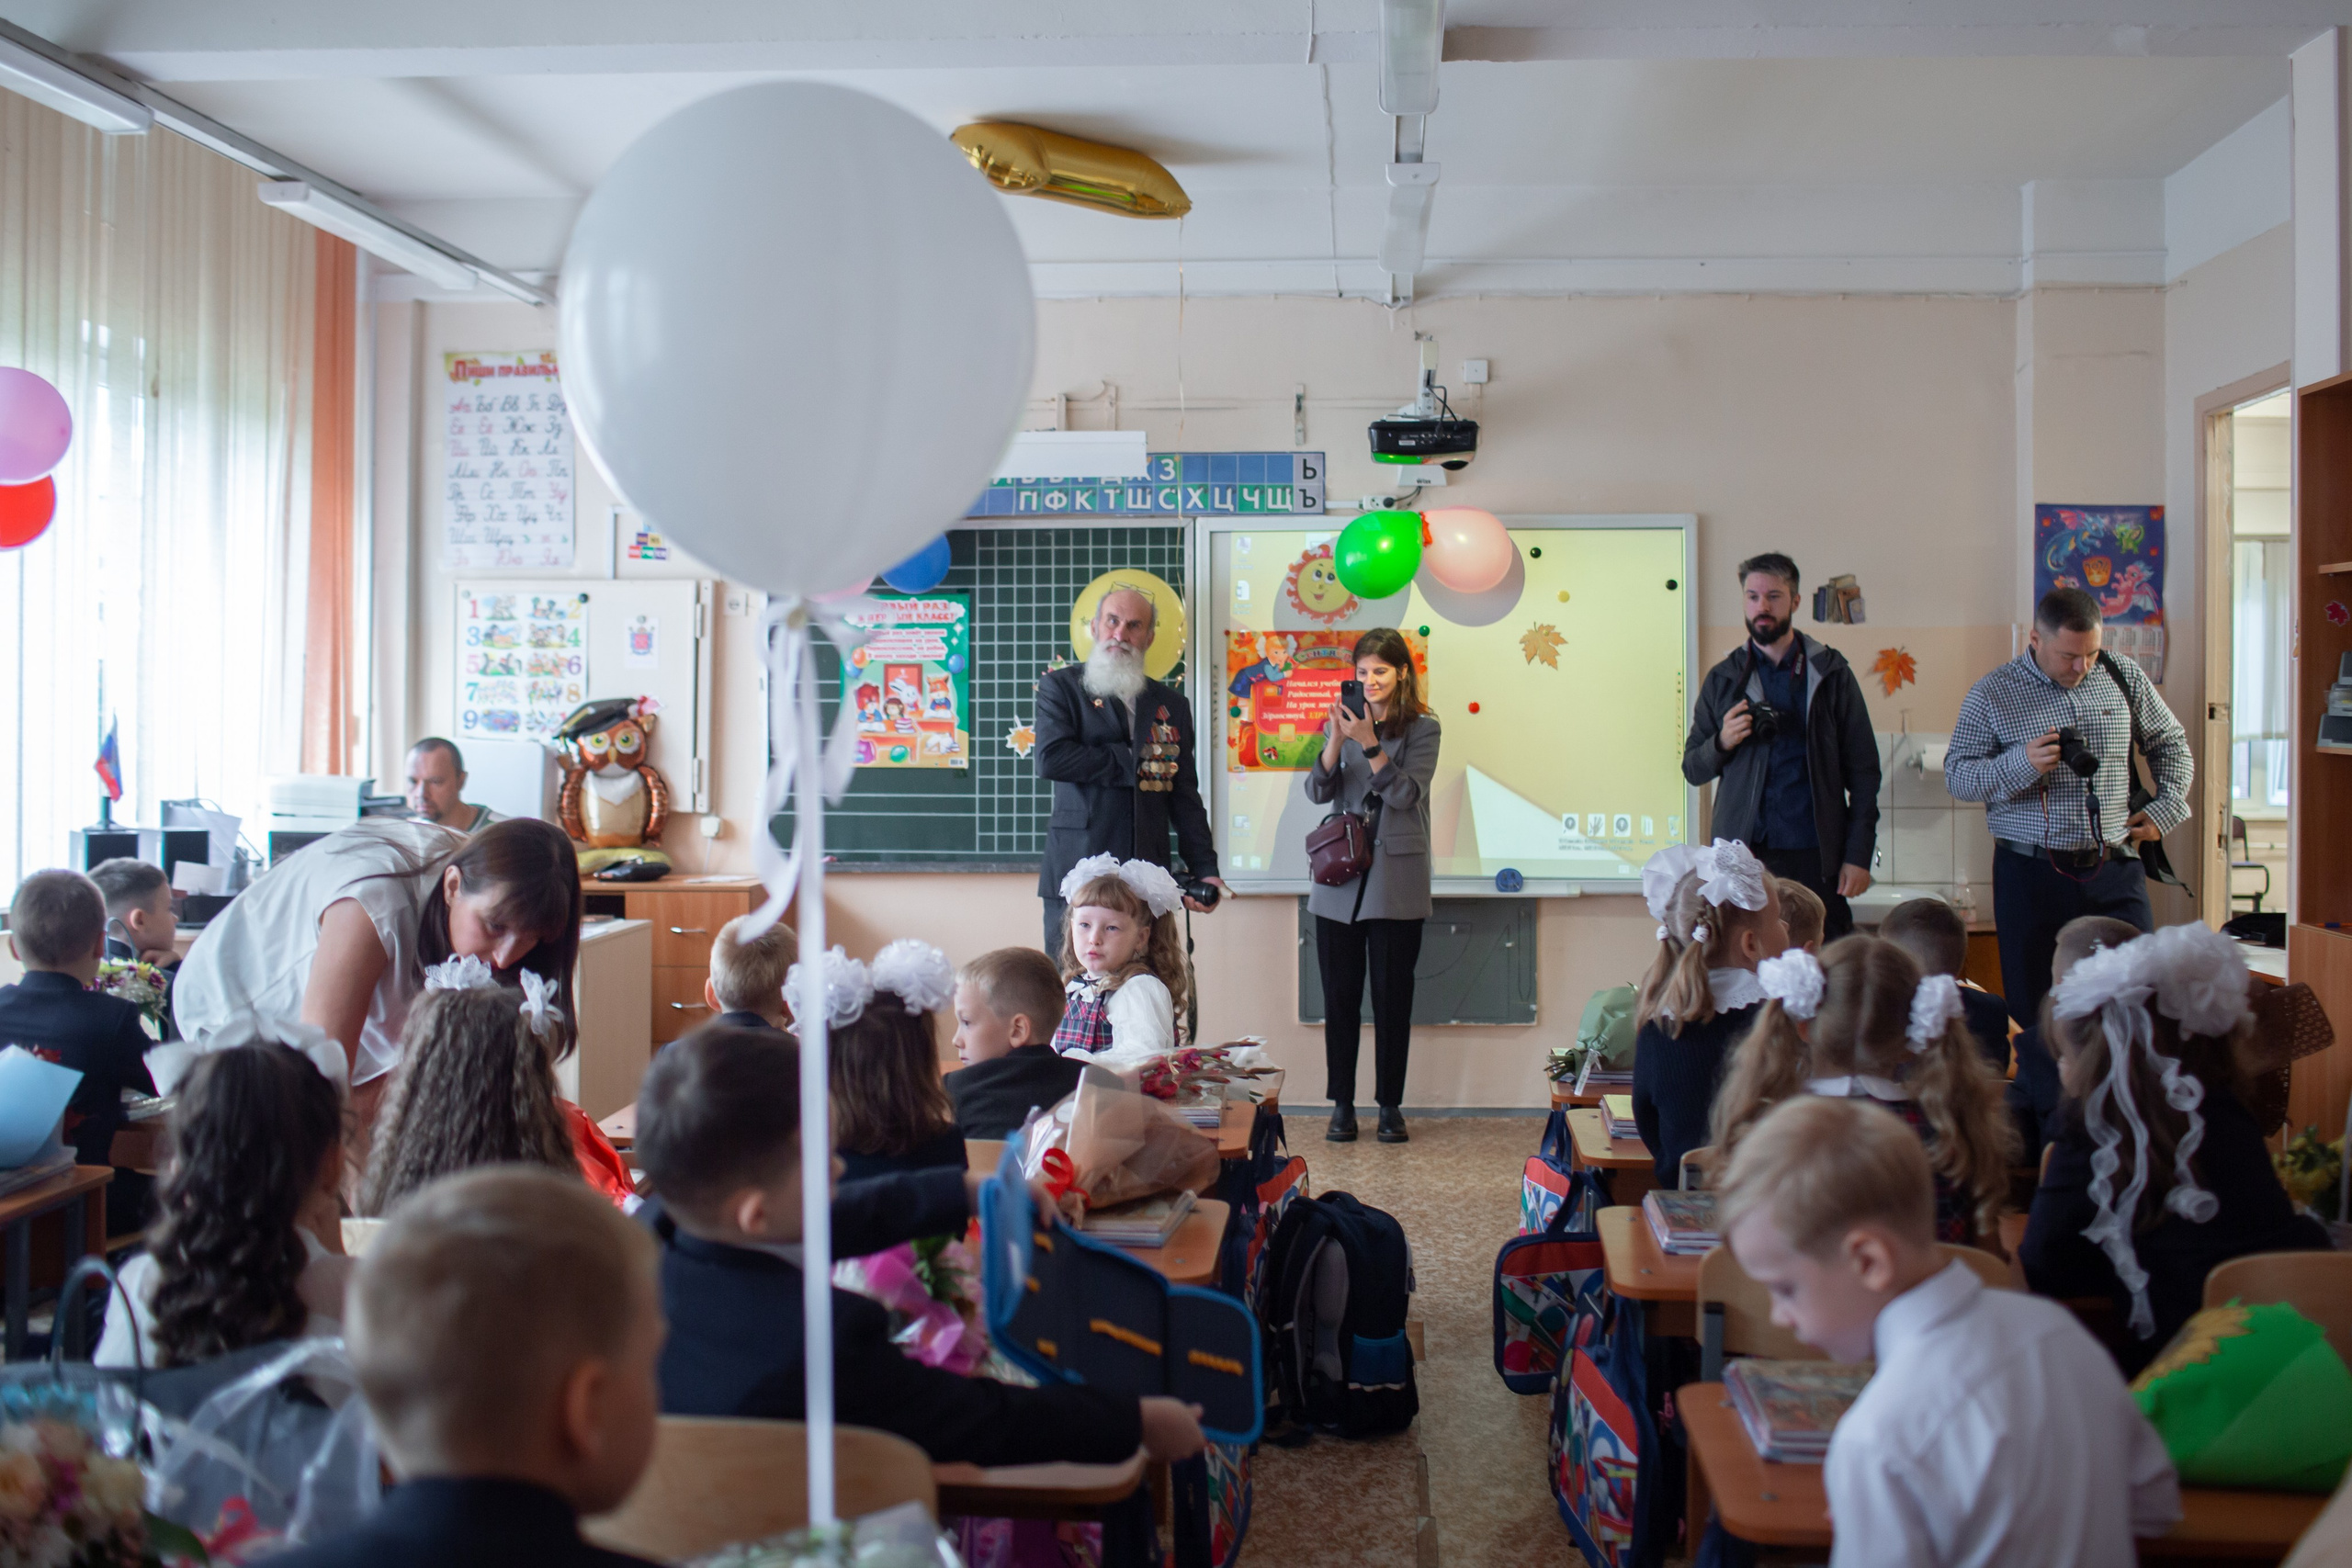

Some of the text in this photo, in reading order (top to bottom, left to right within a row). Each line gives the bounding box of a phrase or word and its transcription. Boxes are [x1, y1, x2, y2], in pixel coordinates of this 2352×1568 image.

[475, 395, 496, 412] Бб
[500, 395, 519, 412] Вв
[503, 416, 536, 434] Жж
[1159, 458, 1176, 481] З
[469, 599, 479, 618] 1
[568, 599, 582, 619] 2
[922, 602, 948, 611] РАЗ
[867, 614, 912, 622] ПЕРЫЙ
[466, 626, 481, 647] 3
[567, 627, 582, 647] 4
[466, 654, 480, 674] 5
[568, 655, 582, 675] 6
[1298, 649, 1353, 662] СЕНТЯБР
[465, 682, 480, 701] 7
[566, 683, 581, 704] 8
[463, 709, 479, 729] 9
